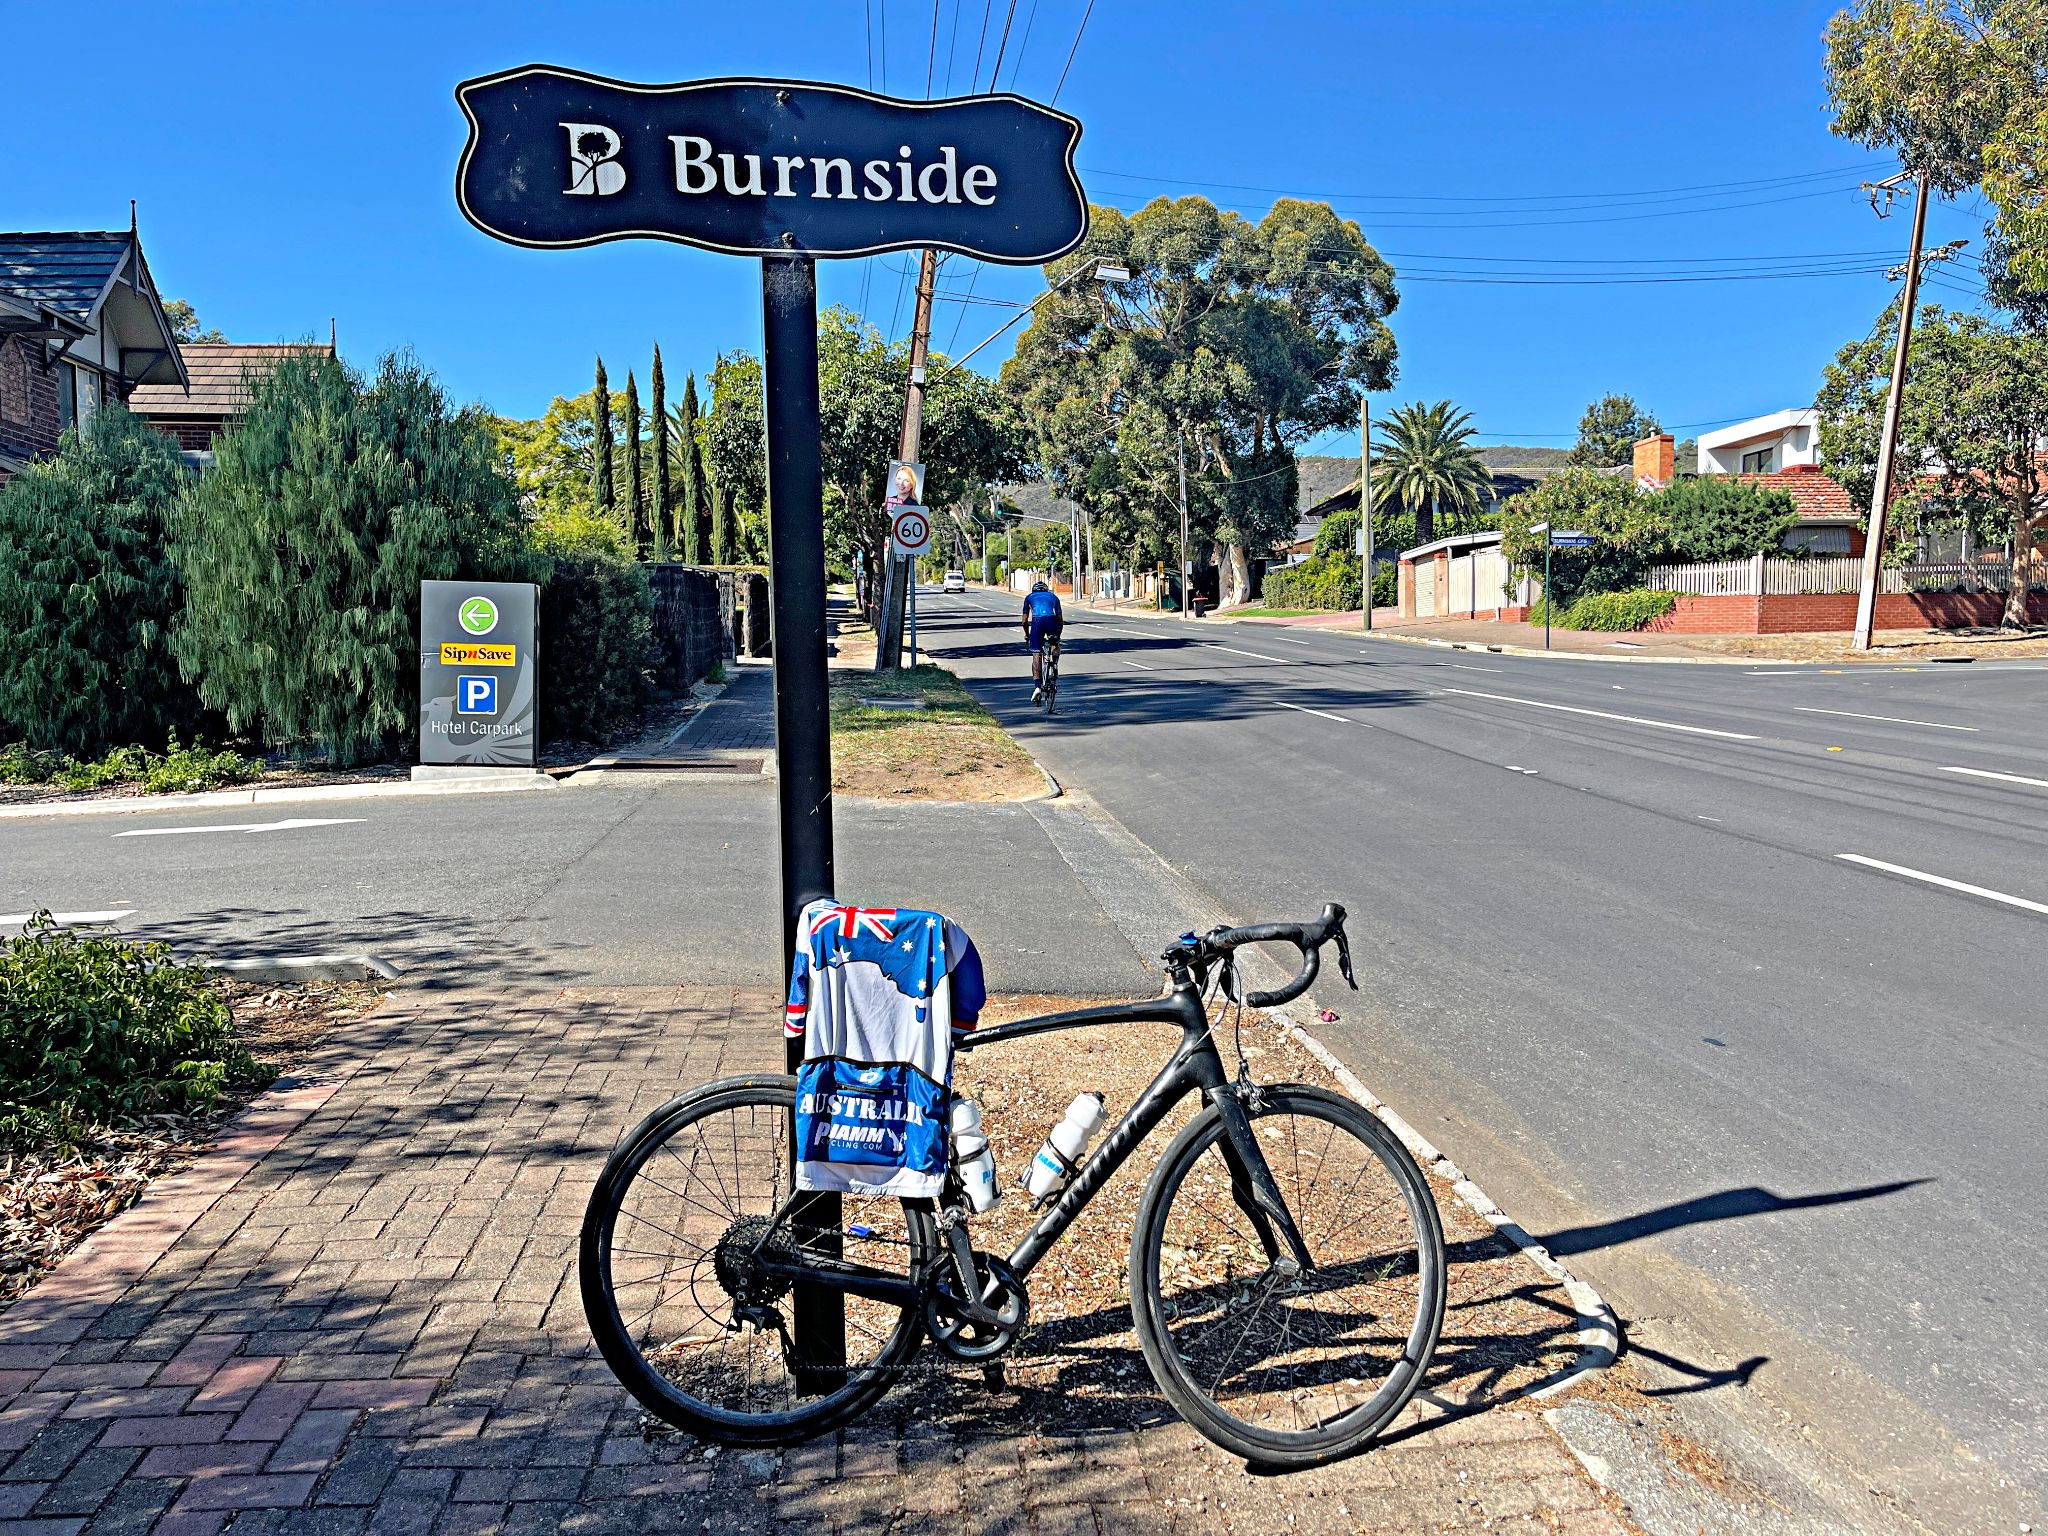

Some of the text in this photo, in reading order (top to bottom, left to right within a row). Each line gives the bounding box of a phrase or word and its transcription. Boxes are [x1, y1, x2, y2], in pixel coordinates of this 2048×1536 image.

[668, 135, 997, 206] Burnside
[901, 522, 923, 538] 60
[467, 680, 491, 709] P
[431, 720, 523, 738] Hotel Carpark
